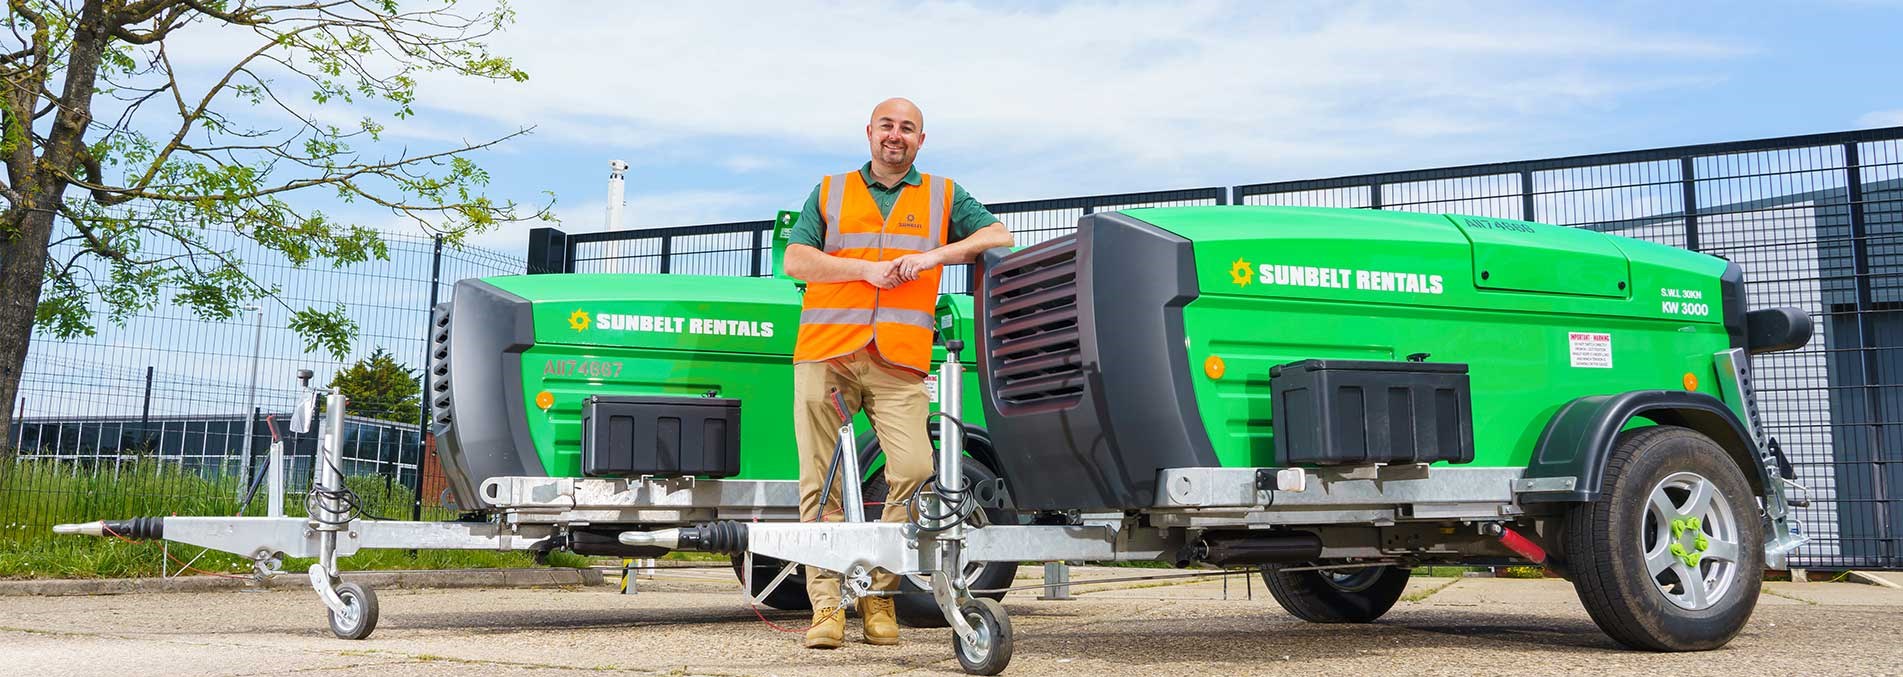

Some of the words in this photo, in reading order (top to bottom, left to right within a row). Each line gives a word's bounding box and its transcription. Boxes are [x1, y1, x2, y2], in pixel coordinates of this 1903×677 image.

[1259, 263, 1351, 289] SUNBELT
[1356, 269, 1443, 295] RENTALS
[1661, 301, 1679, 314] KW
[1681, 302, 1709, 316] 3000
[596, 313, 685, 333] SUNBELT
[689, 318, 774, 337] RENTALS
